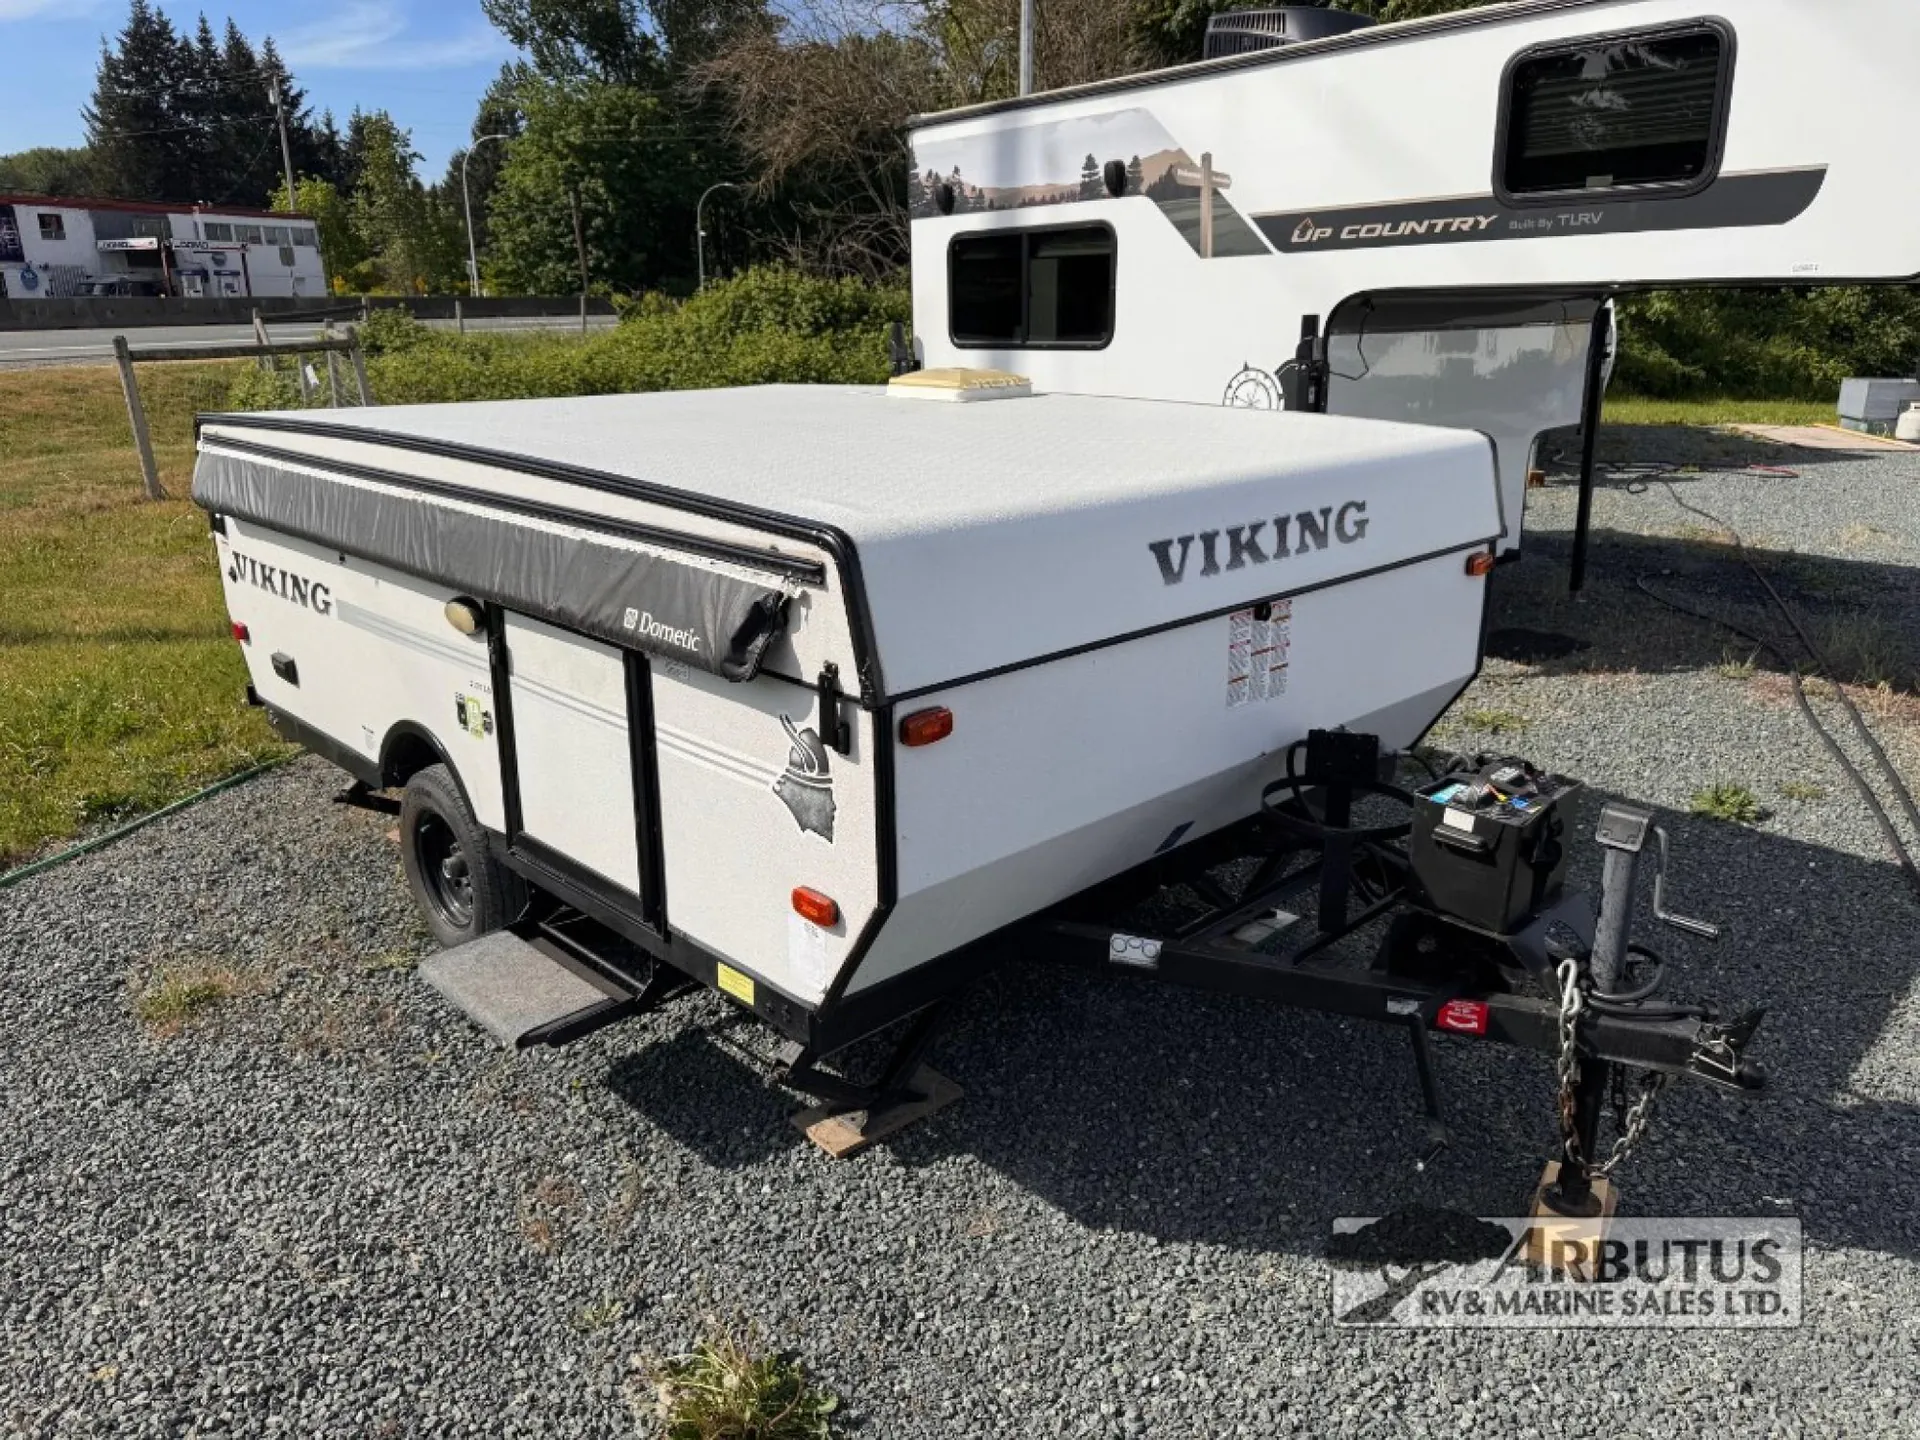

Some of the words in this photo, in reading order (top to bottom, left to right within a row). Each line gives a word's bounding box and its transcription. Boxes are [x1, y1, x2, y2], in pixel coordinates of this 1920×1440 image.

[1291, 217, 1332, 243] UP
[1340, 214, 1498, 239] COUNTRY
[1509, 218, 1535, 230] Built
[1538, 218, 1554, 231] By
[1558, 211, 1604, 226] TLRV
[1148, 500, 1370, 586] VIKING
[231, 551, 333, 616] VIKING
[638, 611, 702, 652] Dometic
